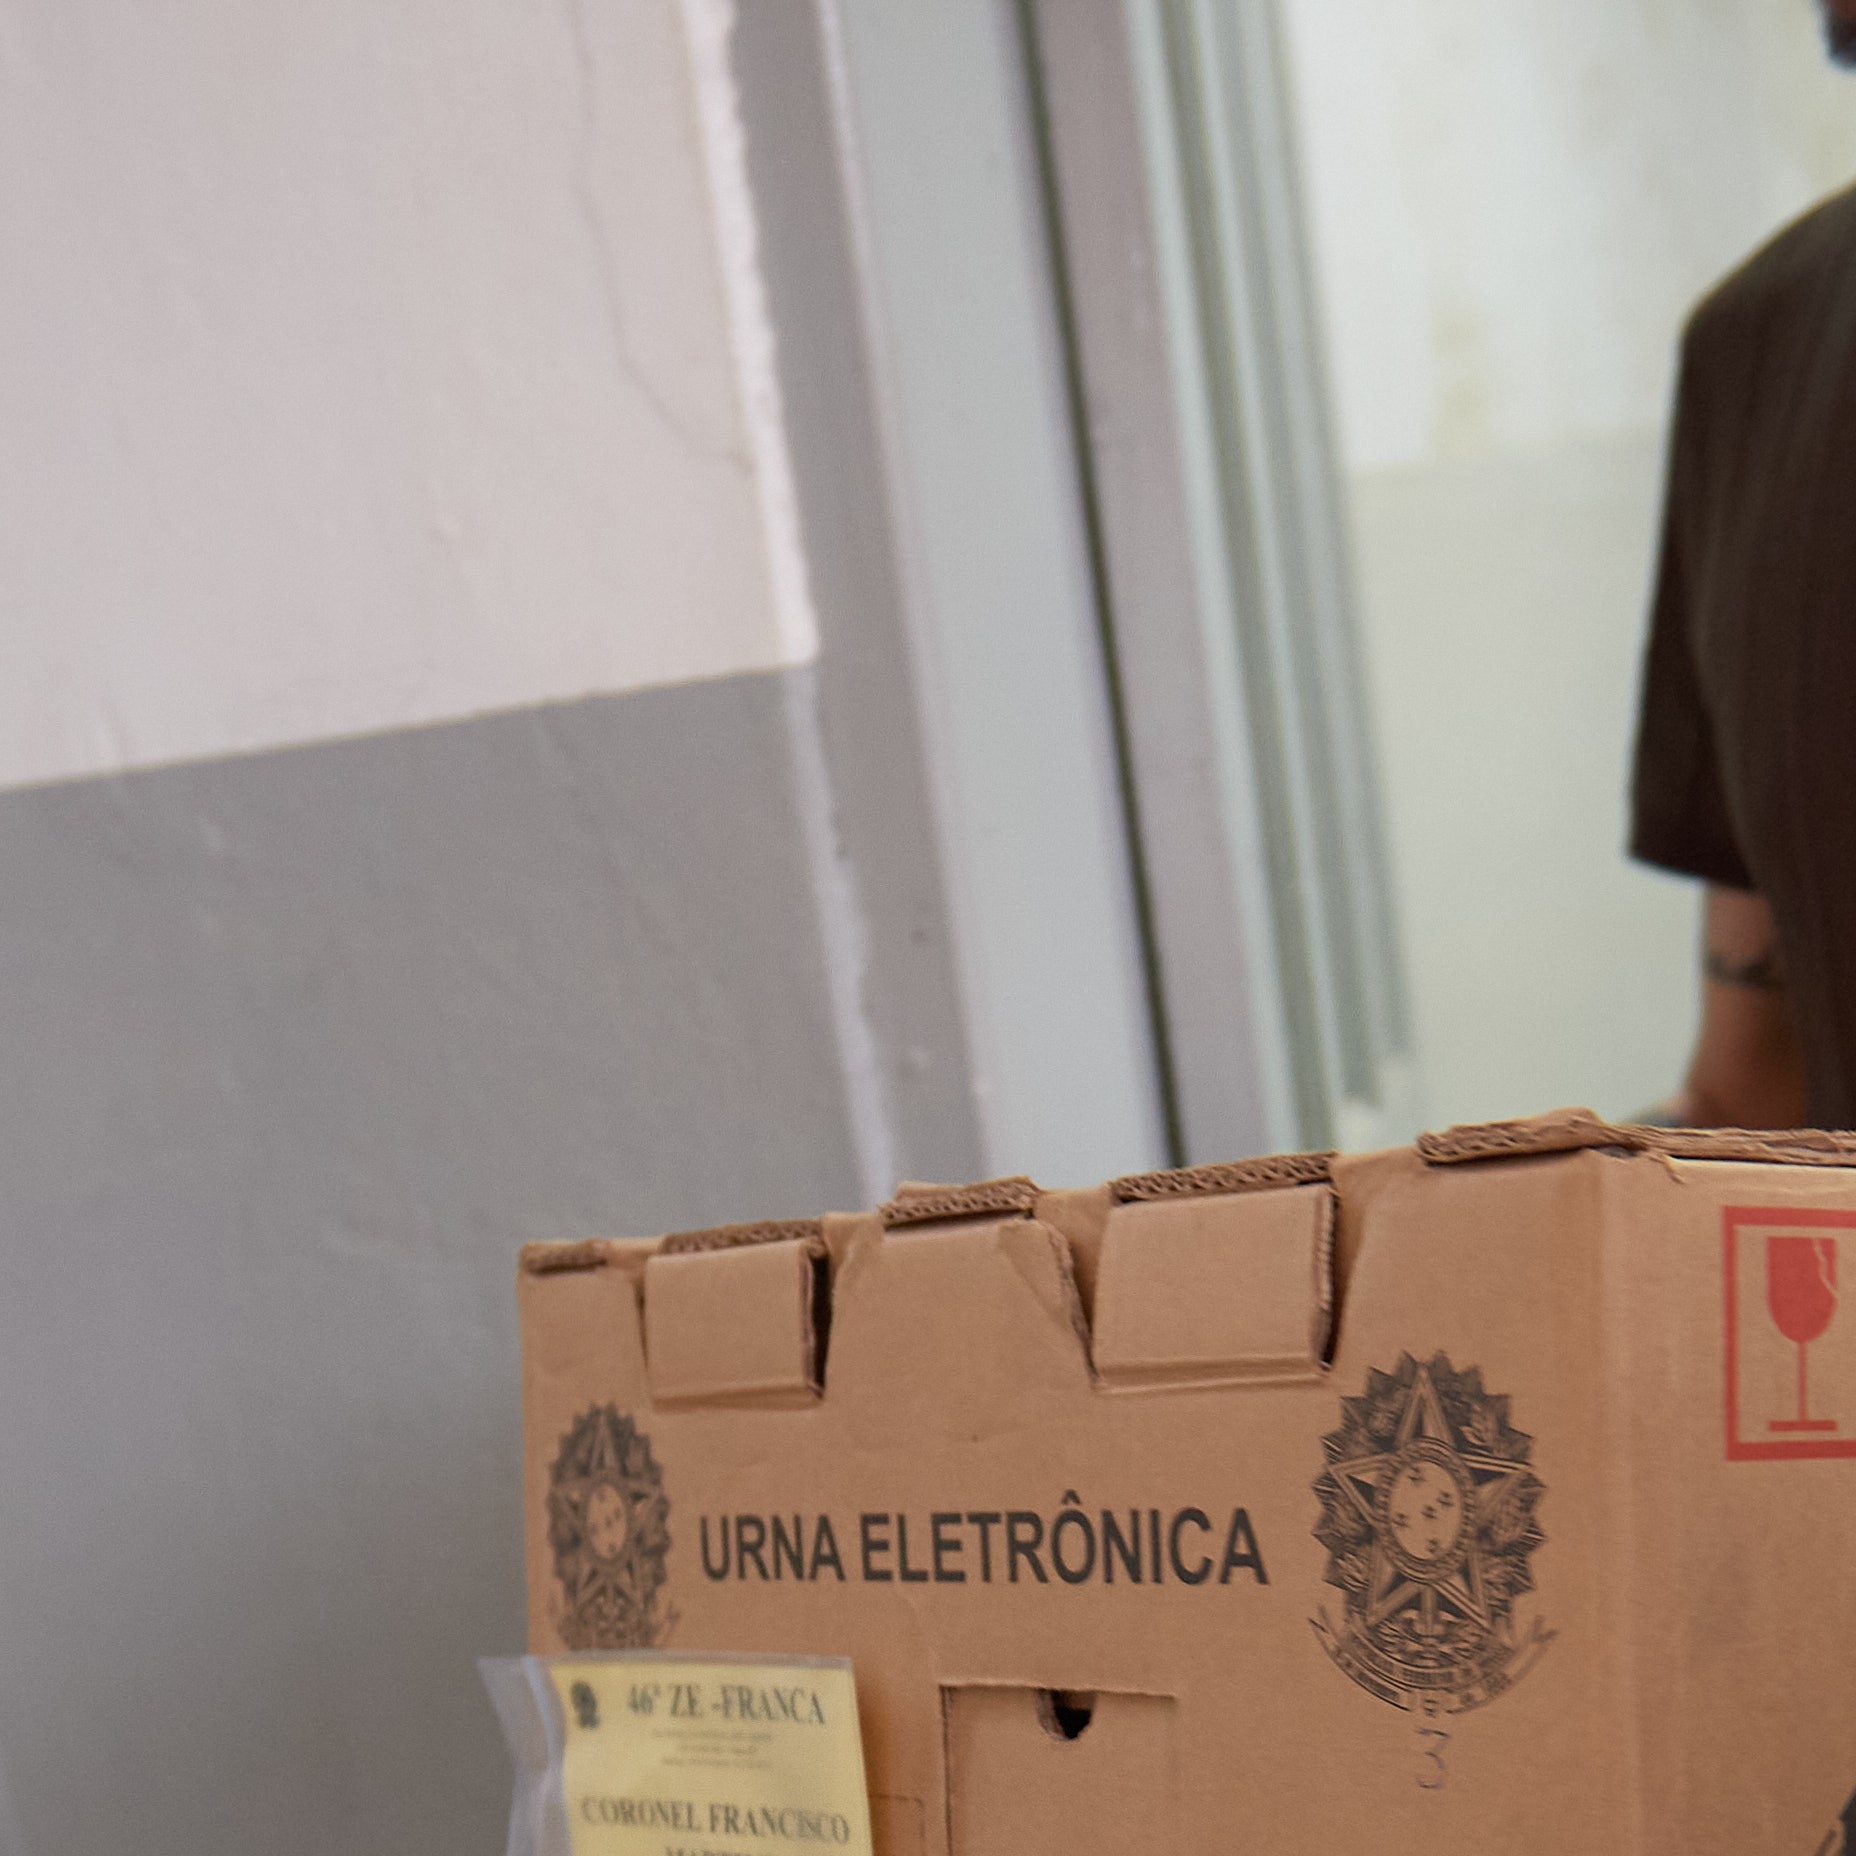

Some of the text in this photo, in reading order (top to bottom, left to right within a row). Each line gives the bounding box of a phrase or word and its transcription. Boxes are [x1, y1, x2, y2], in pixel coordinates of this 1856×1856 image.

[700, 1490, 1271, 1585] URNA ELETRÔNICA
[668, 1684, 703, 1719] ZE
[581, 1797, 850, 1846] CORONEL FRANCISCO
